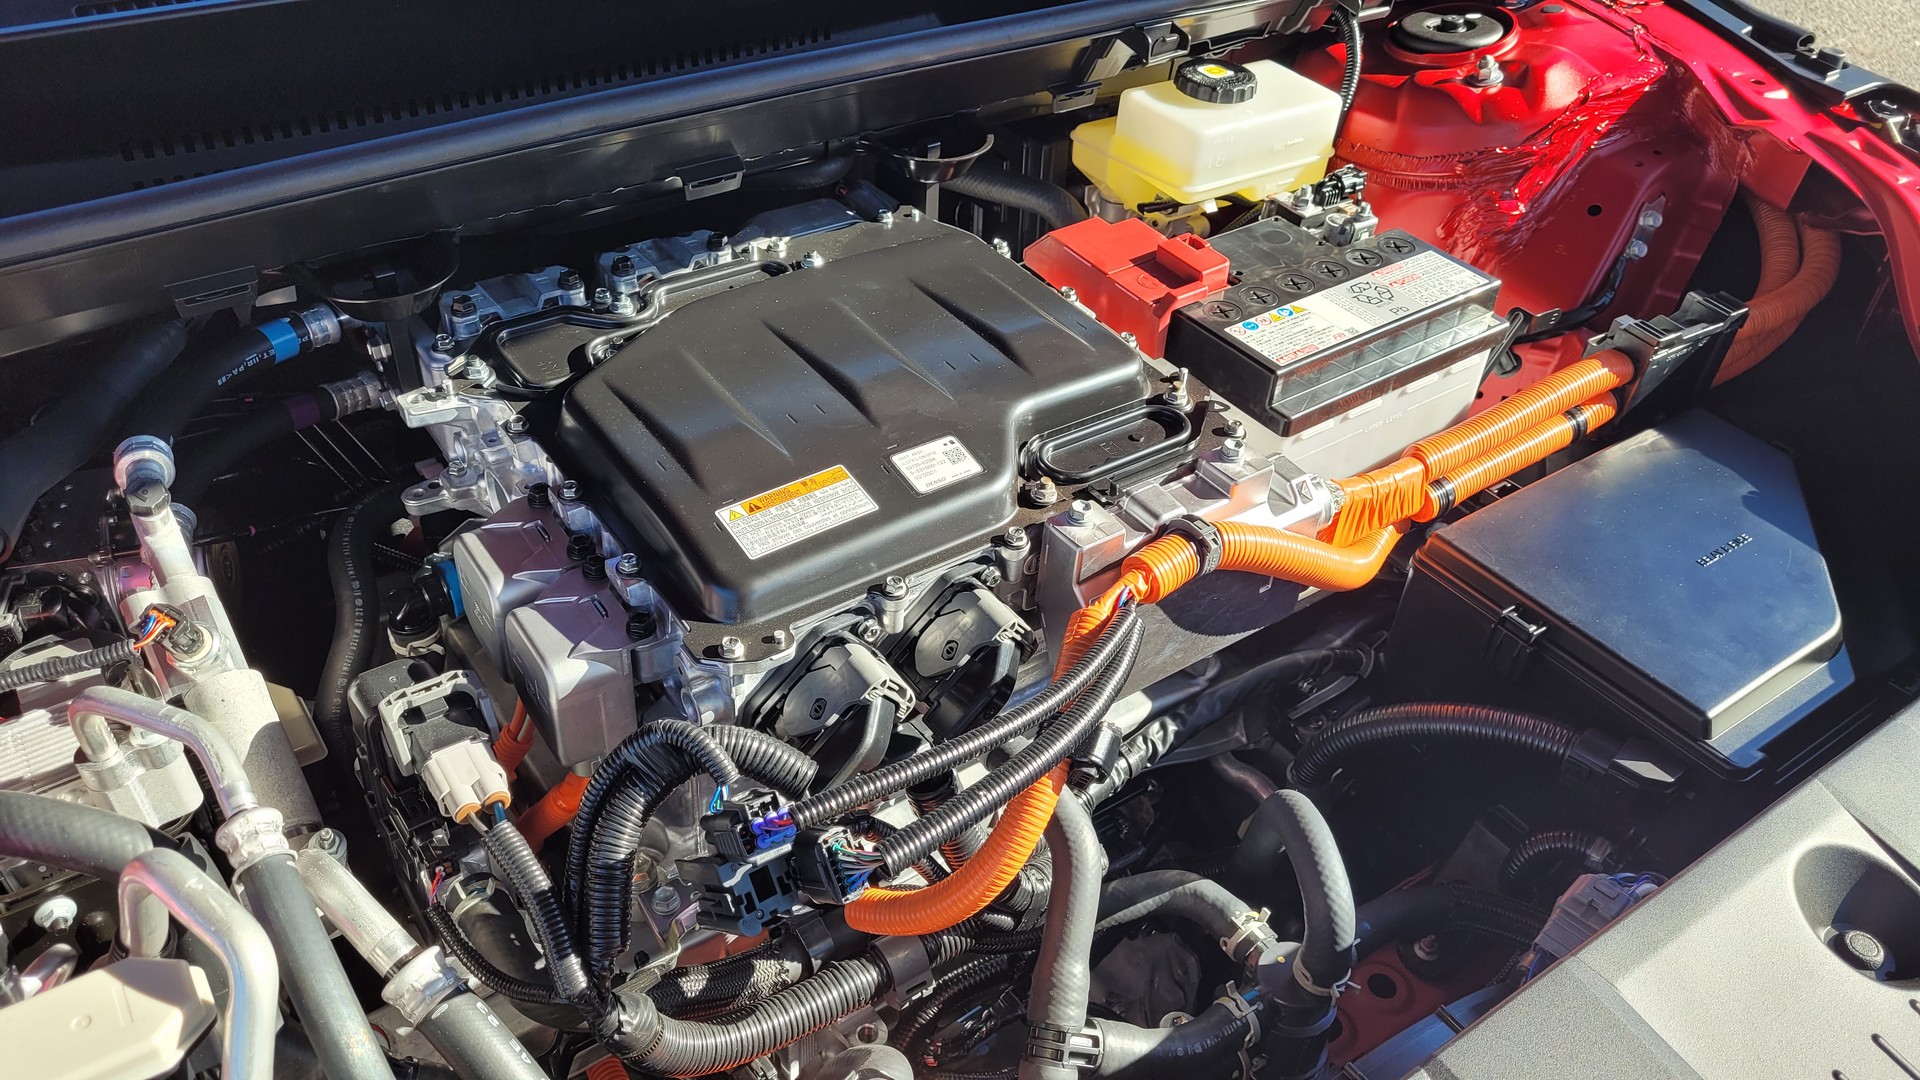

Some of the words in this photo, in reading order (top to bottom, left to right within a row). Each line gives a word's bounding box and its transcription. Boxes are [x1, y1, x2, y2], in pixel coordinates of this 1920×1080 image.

[1390, 306, 1410, 316] Pb
[925, 477, 947, 488] DENSO
[756, 487, 790, 503] WARNING
[760, 489, 802, 508] AVERTISSEMENT
[476, 1001, 500, 1028] 23
